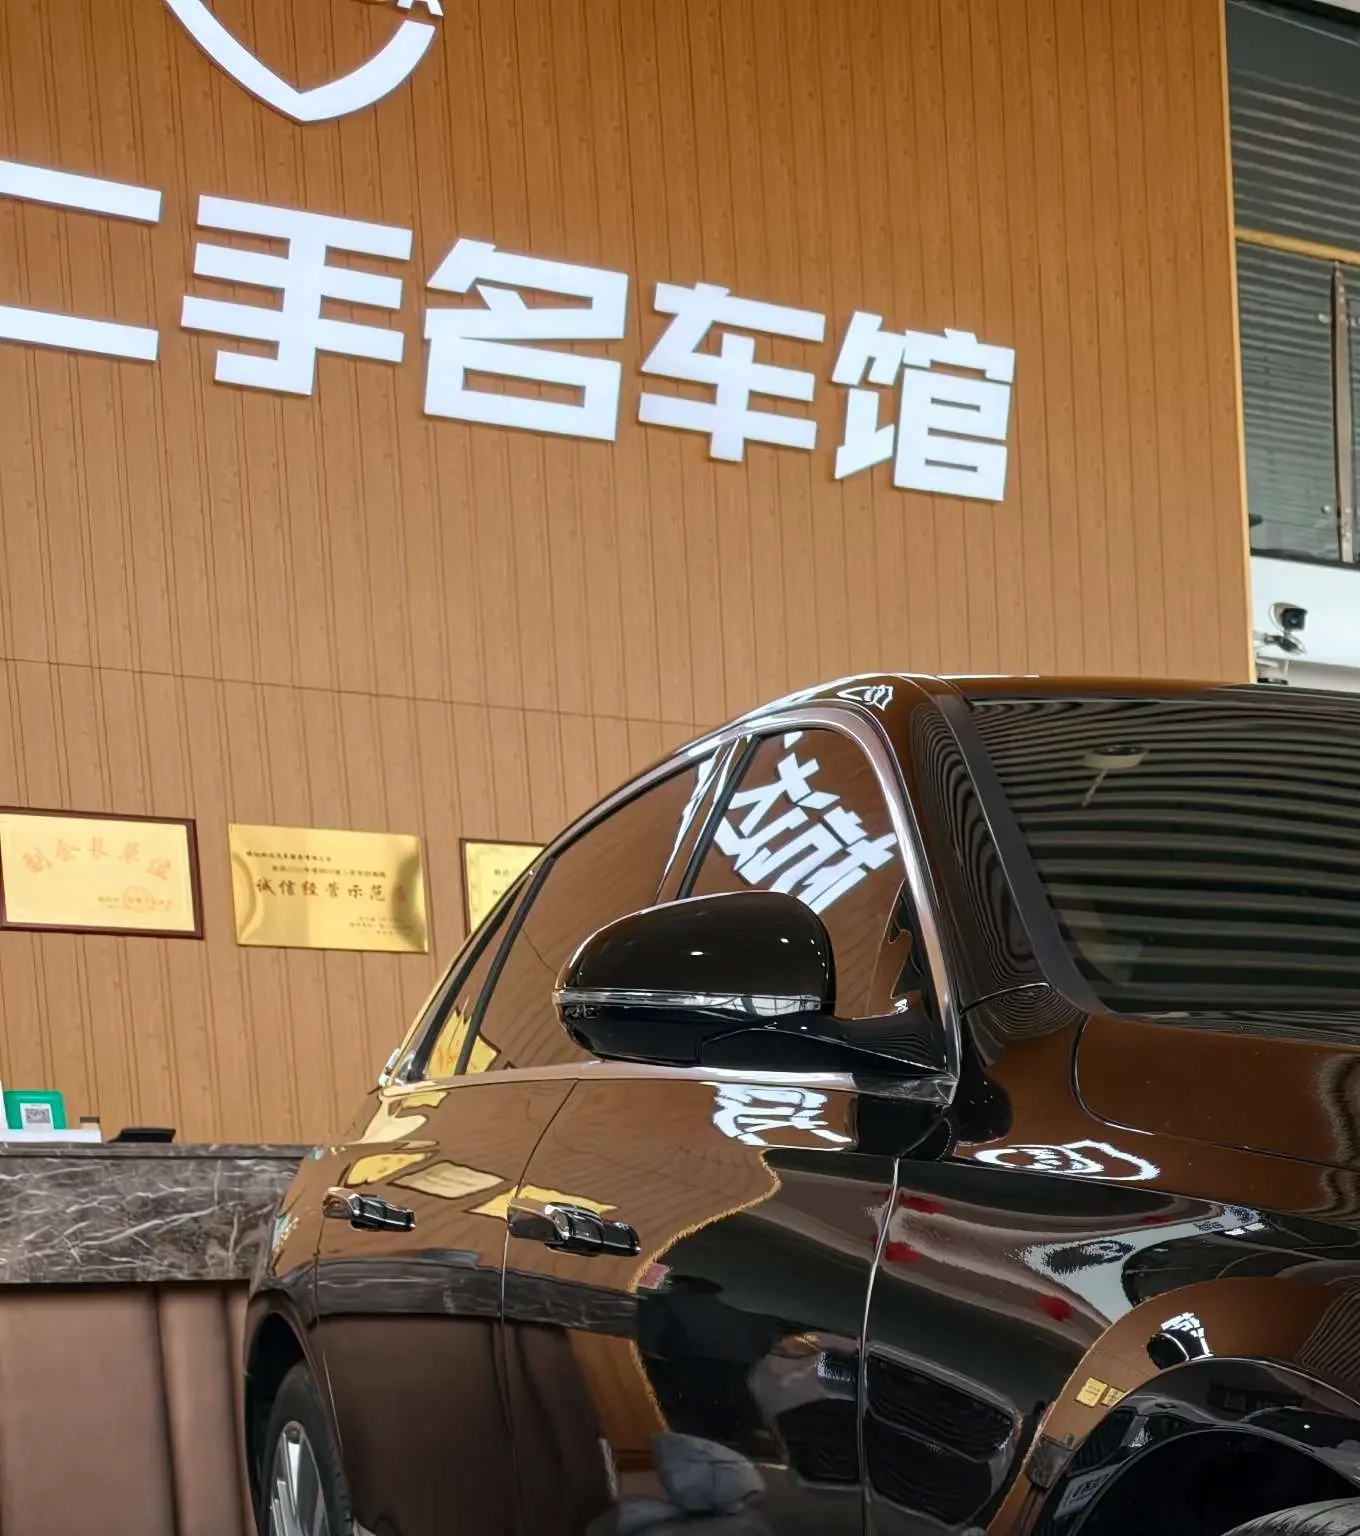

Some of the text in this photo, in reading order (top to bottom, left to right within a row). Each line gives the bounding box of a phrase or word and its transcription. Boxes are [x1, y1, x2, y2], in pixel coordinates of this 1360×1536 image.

[0, 159, 1015, 501] 二手名车馆
